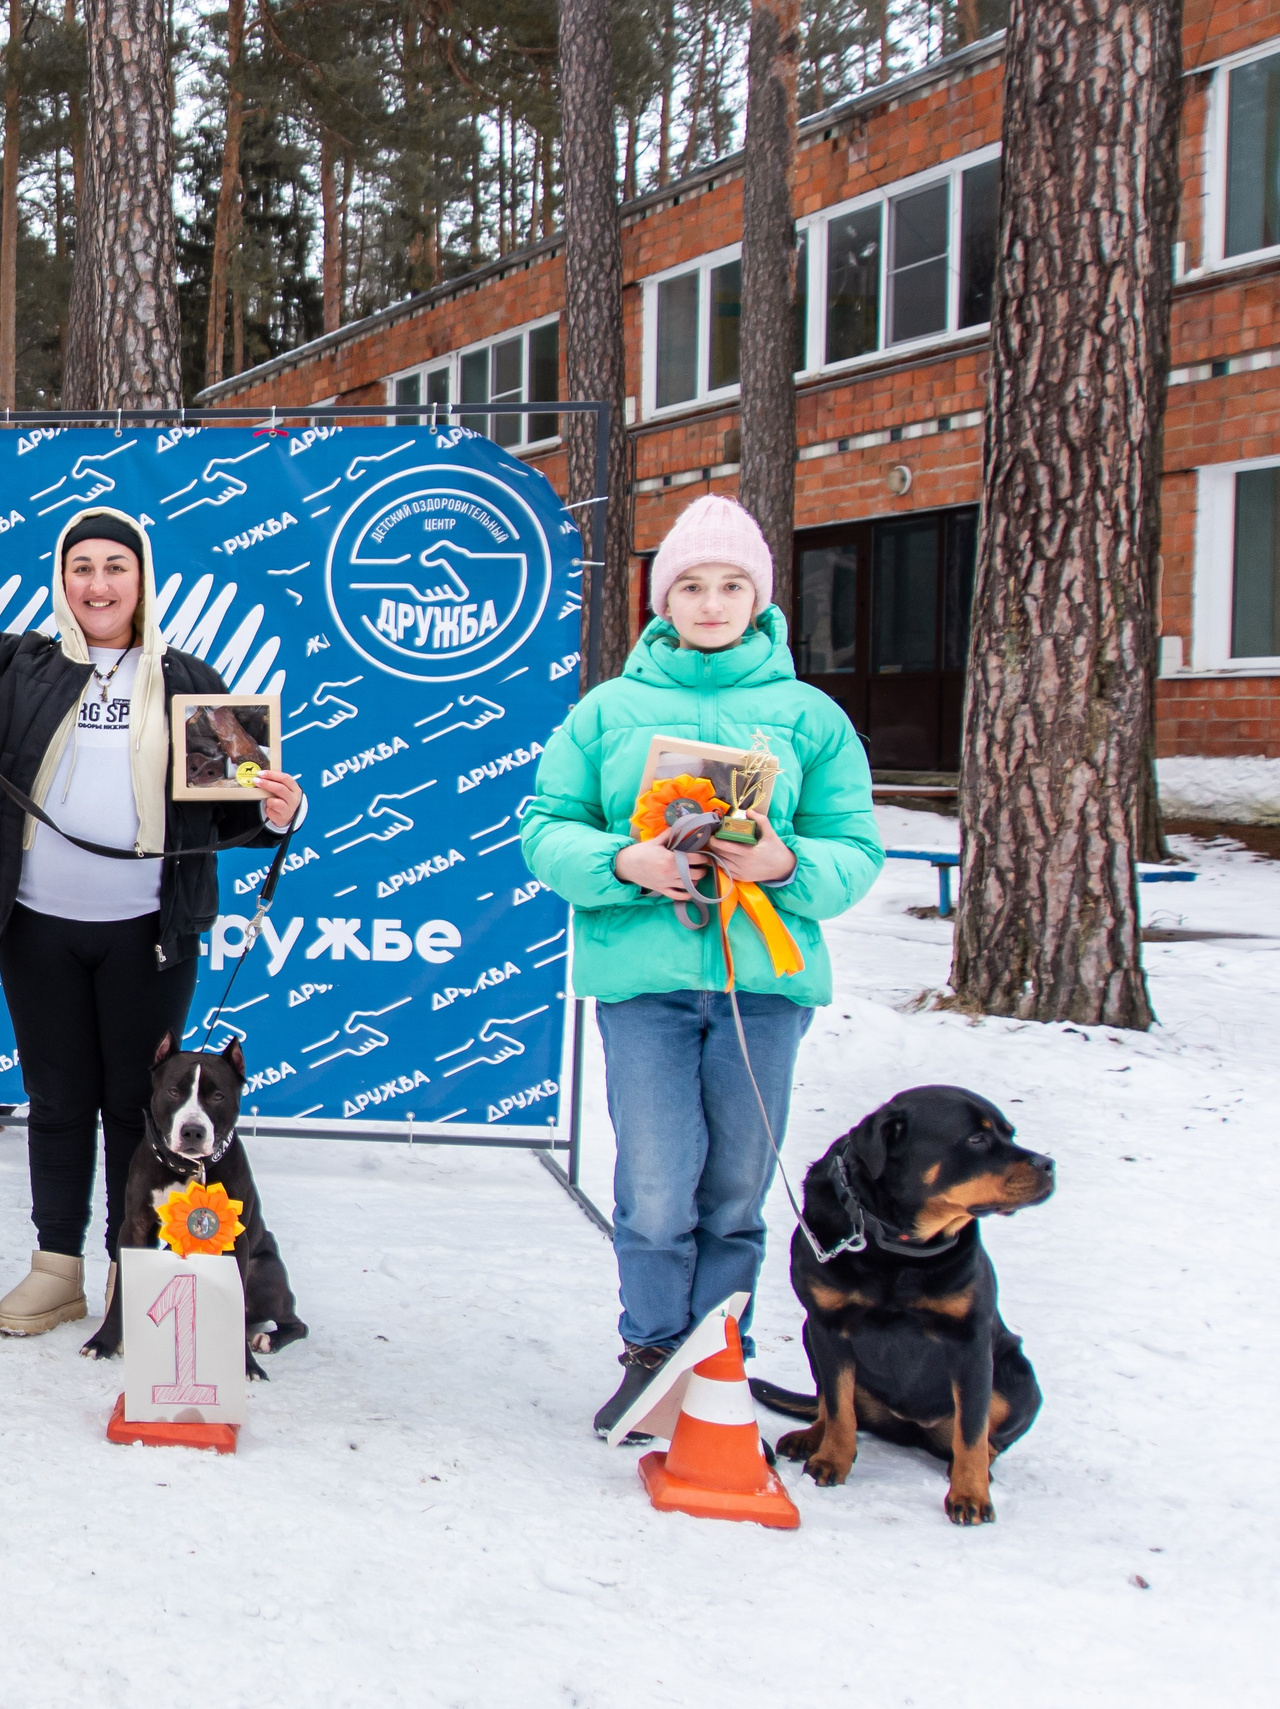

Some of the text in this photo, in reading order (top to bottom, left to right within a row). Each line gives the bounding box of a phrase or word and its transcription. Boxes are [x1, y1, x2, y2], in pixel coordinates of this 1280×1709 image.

[371, 498, 510, 544] ДЕТСКИЙ ОЗДОРОВИТЕЛЬНЫЙ
[424, 518, 457, 531] ЦЕНТР
[376, 598, 499, 649] ДРУЖБА
[106, 703, 130, 722] SP
[322, 736, 410, 788] ДРУЖБА
[457, 741, 545, 794] ДРУЖБА
[377, 849, 466, 898] ДРУЖБА
[200, 914, 462, 977] ружбе
[343, 1069, 431, 1119] ДРУЖБА
[487, 1079, 559, 1123] ДРУЖБ
[147, 1274, 220, 1405] 1
